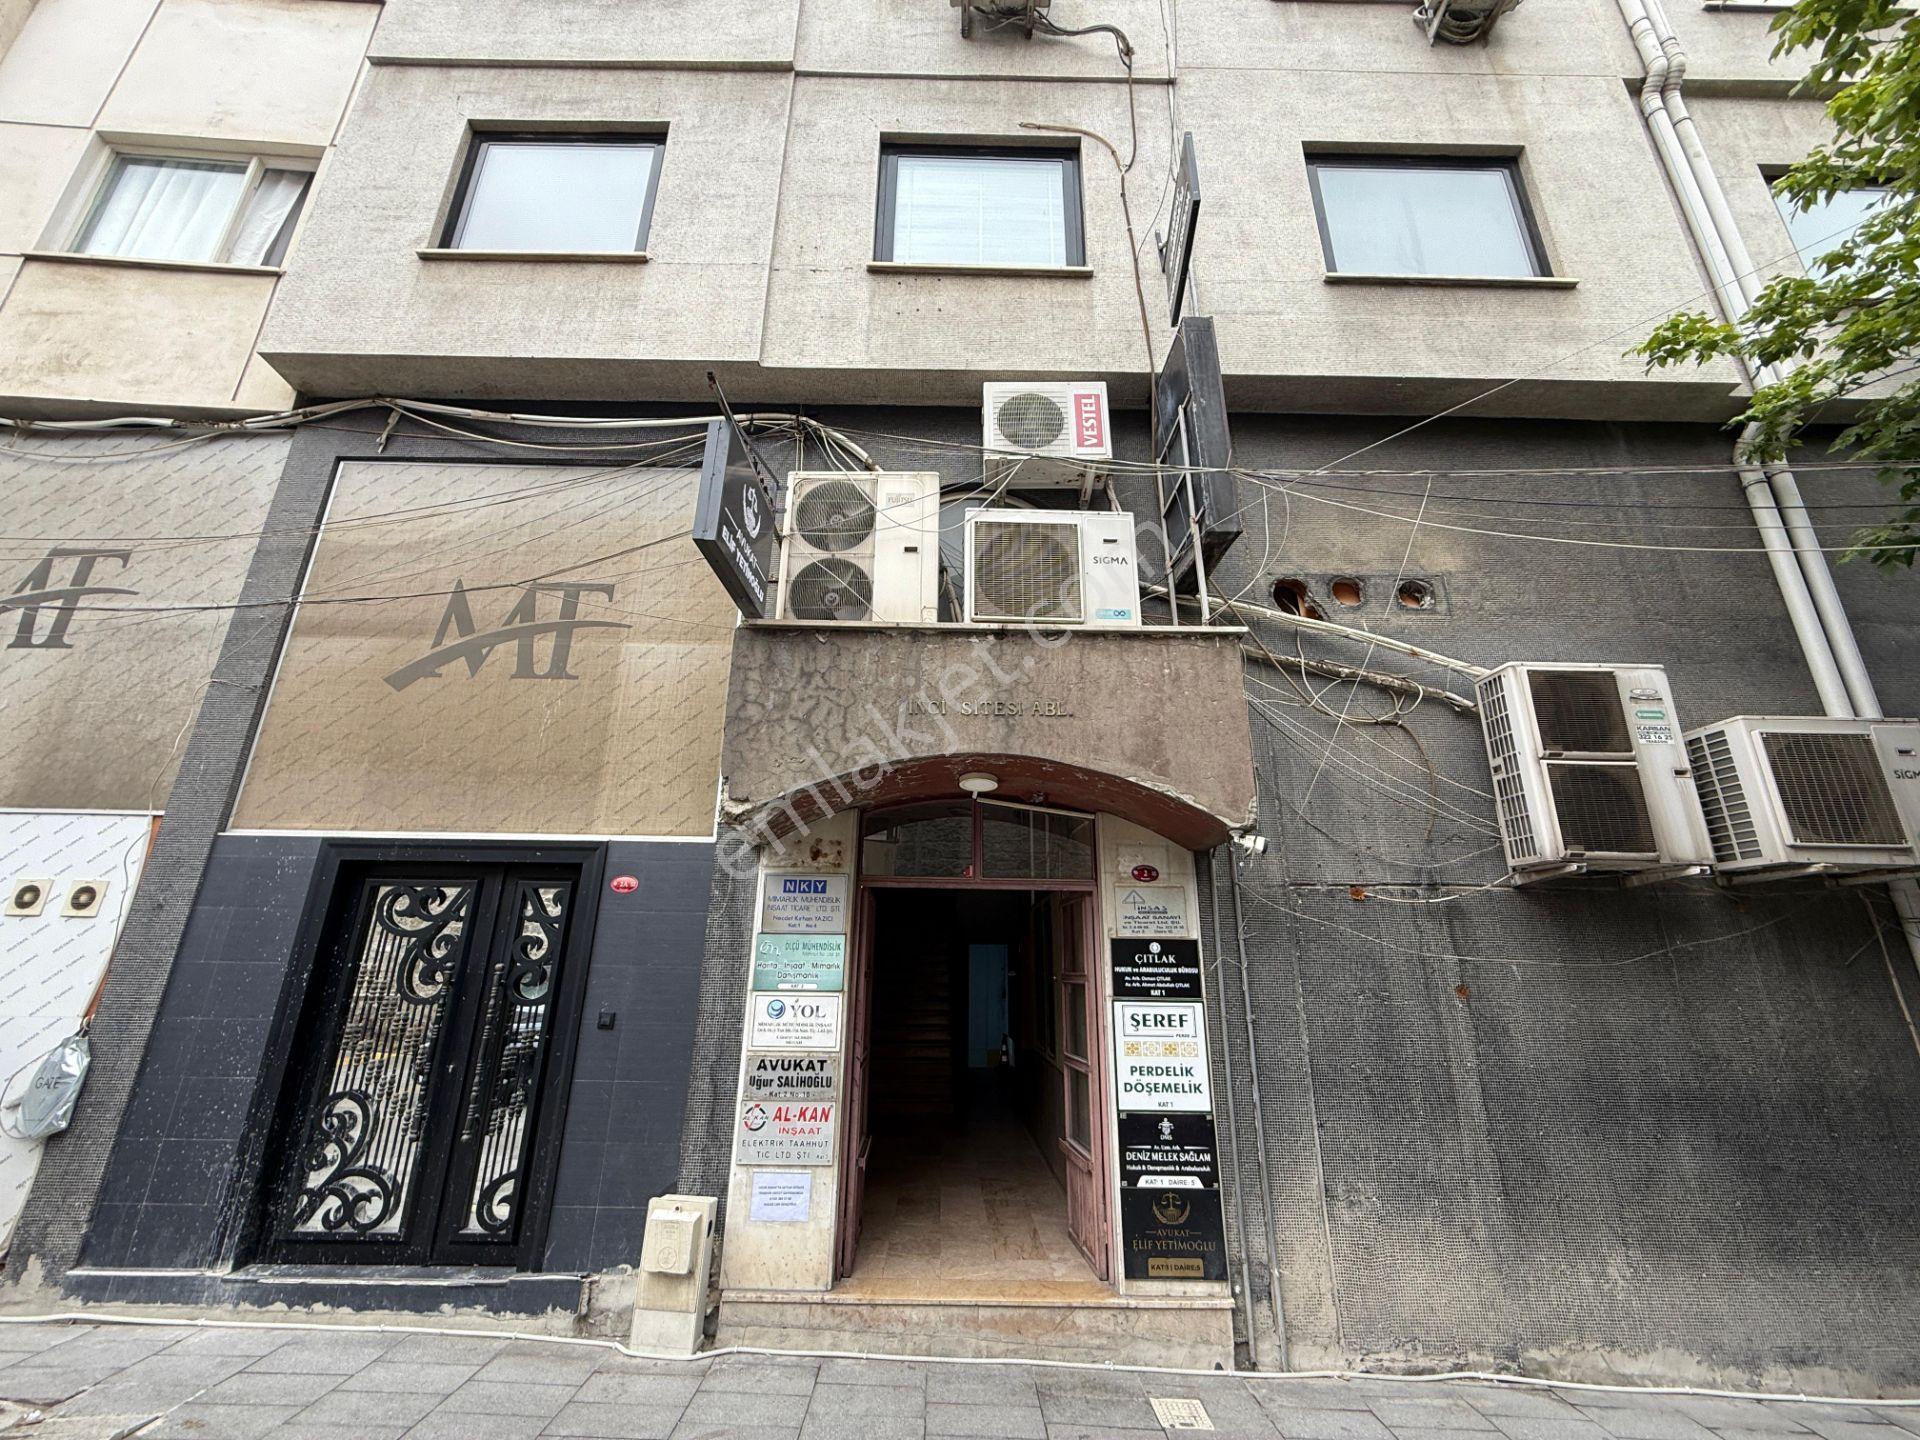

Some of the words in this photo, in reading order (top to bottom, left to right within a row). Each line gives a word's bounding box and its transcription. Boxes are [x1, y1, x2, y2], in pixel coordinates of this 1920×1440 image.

[1082, 395, 1098, 446] VESTEL
[736, 529, 758, 569] AVUKAT
[785, 881, 826, 892] NKY
[1134, 954, 1176, 964] ÇITLAK
[1130, 1013, 1188, 1032] ŞEREF
[756, 1059, 828, 1072] AVUKAT
[1130, 1063, 1194, 1077] PERDELİK
[749, 1074, 774, 1090] Uğur
[777, 1073, 832, 1088] SALİHOĞLU
[1124, 1079, 1203, 1096] DÖŞEMELİK
[772, 1106, 832, 1122] AL-KAN
[1126, 1150, 1150, 1161] DENİZ
[1151, 1152, 1178, 1161] MELEK
[1179, 1151, 1211, 1162] SAĞLAM
[1157, 1229, 1190, 1237] AVUKAT
[1133, 1239, 1153, 1250] ELİF
[1155, 1239, 1216, 1252] YETİMOĞLU
